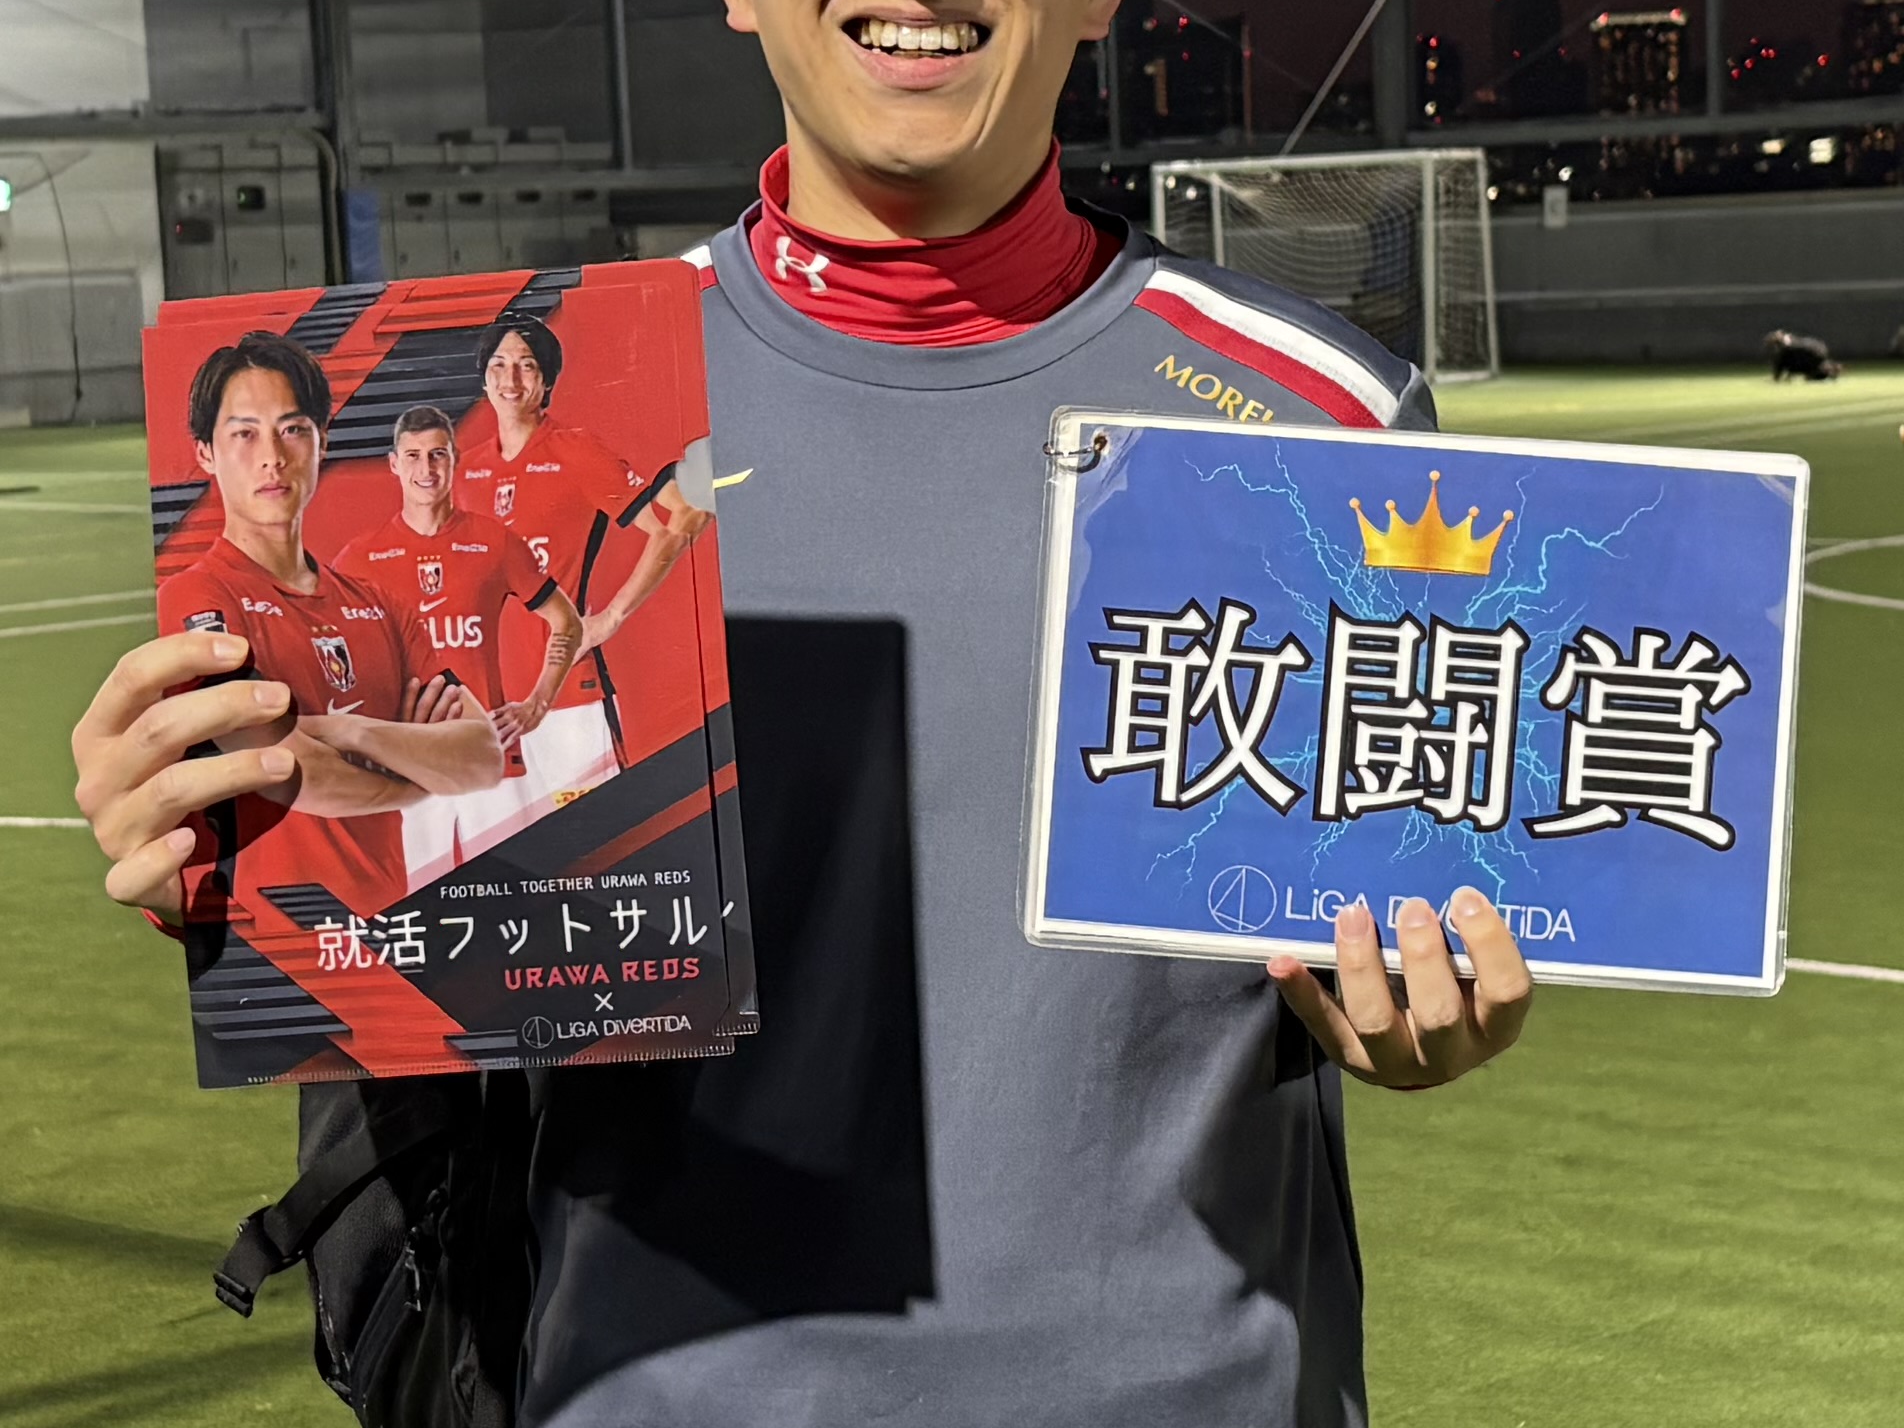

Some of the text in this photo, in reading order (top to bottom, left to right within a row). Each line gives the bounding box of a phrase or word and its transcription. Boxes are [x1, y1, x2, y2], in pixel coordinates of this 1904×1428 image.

[1153, 354, 1275, 423] MORE
[417, 615, 483, 649] LUS
[1080, 597, 1752, 851] 敢闘賞
[439, 870, 692, 899] FOOTBALL TOGETHER URAWA REDS
[314, 895, 708, 972] 就活フットサル
[504, 957, 701, 991] URAWA REDS
